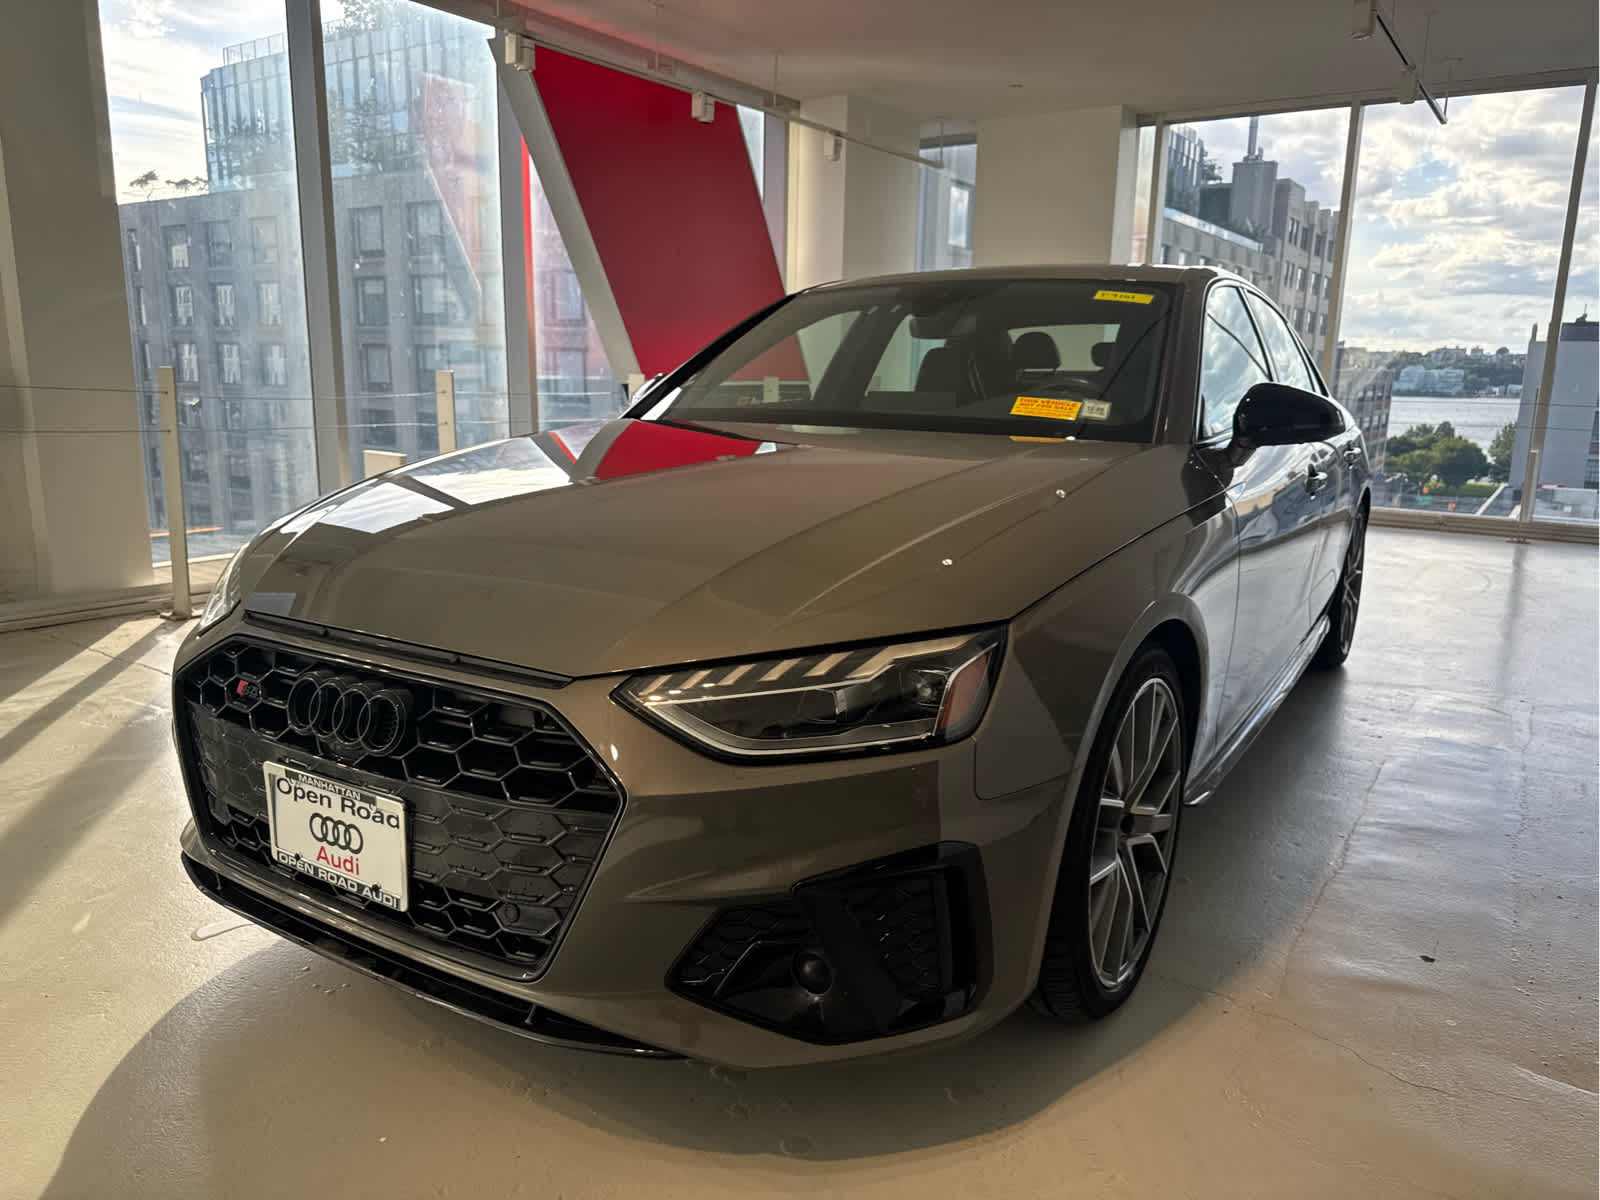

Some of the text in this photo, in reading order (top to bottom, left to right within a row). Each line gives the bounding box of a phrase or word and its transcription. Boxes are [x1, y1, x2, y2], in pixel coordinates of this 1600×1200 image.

[276, 777, 332, 809] Open
[298, 774, 360, 800] MANHATTAN
[316, 845, 360, 876] Audi
[278, 853, 399, 909] OPEN ROAD AUDI
